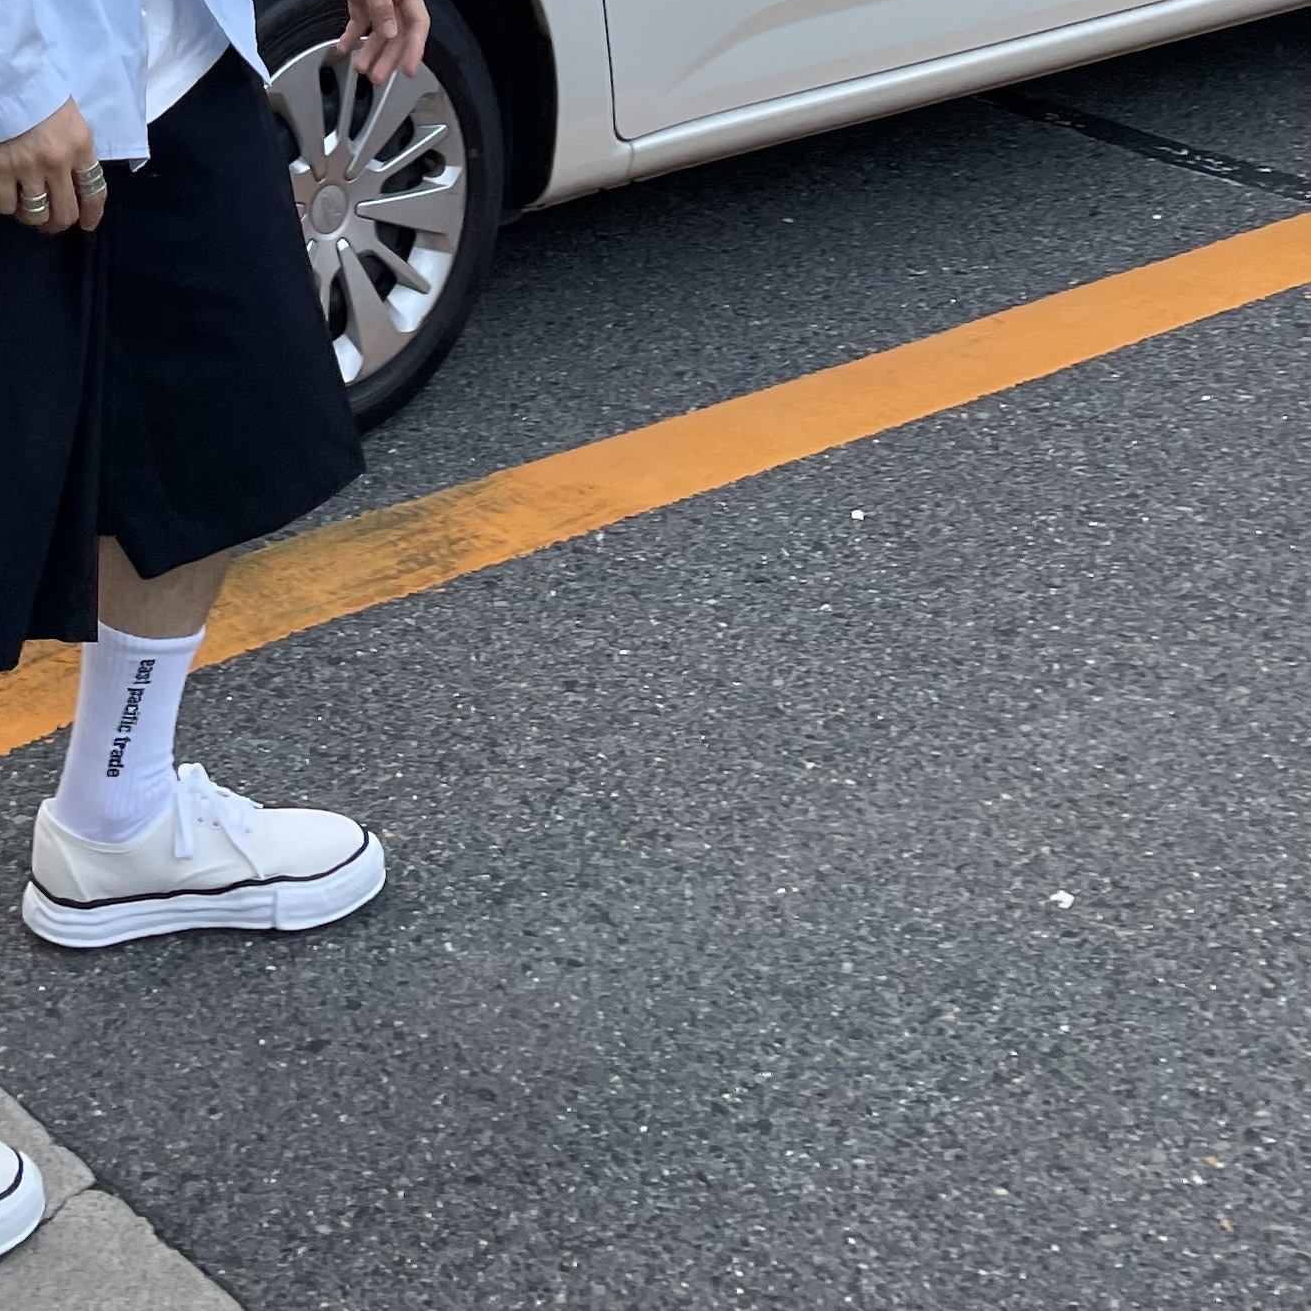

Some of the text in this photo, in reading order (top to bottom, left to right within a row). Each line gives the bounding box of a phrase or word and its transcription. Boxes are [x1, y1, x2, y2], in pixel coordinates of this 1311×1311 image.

[106, 658, 156, 777] east pacific trade
